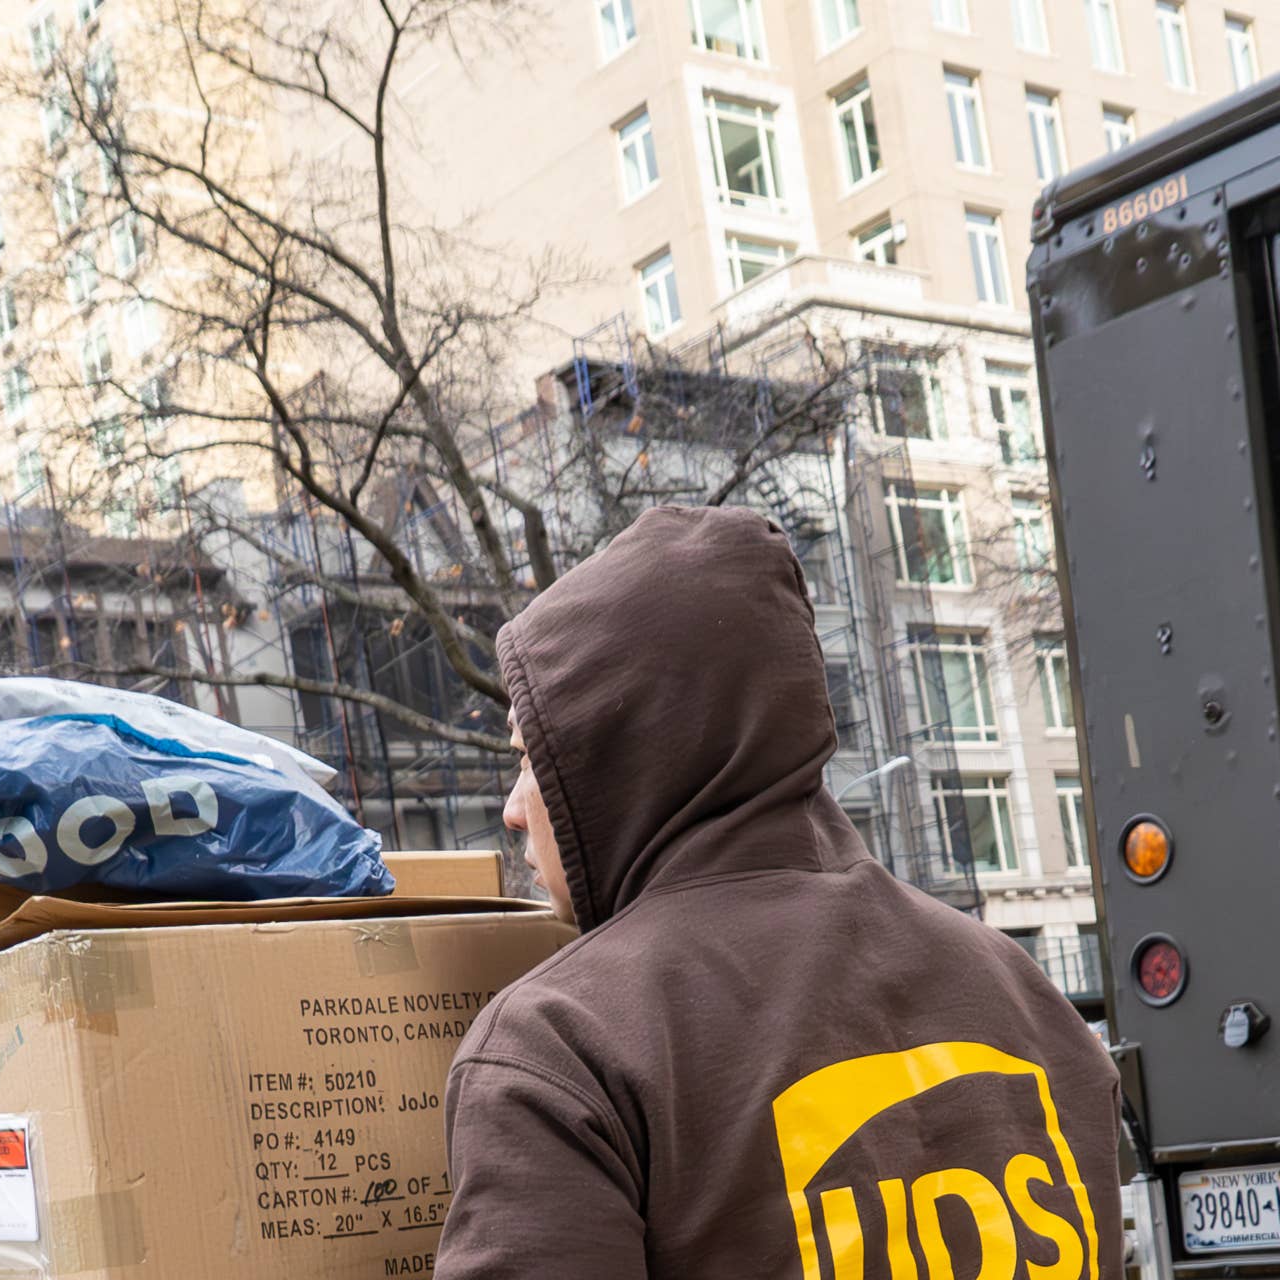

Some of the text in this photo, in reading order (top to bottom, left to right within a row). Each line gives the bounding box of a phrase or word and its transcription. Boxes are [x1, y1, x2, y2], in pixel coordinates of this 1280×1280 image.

[1103, 174, 1188, 234] 866091
[301, 996, 399, 1017] PARKDALE
[404, 992, 482, 1012] NOVELTY
[304, 1024, 400, 1046] TORONTO,
[249, 1073, 293, 1092] ITEM
[324, 1070, 377, 1092] 50210
[251, 1092, 439, 1121] DESCRIPTION: JoJo
[253, 1132, 280, 1151] PO
[314, 1128, 356, 1148] 4149
[256, 1152, 392, 1181] QTY: 12 PCS
[1211, 1170, 1277, 1189] NEW YORK
[258, 1186, 337, 1210] CARTON
[407, 1176, 431, 1195] OF
[261, 1217, 321, 1239] MEAS:
[381, 1210, 393, 1228] X
[1220, 1231, 1280, 1243] COMMERCIAL
[385, 1253, 435, 1276] MADE
